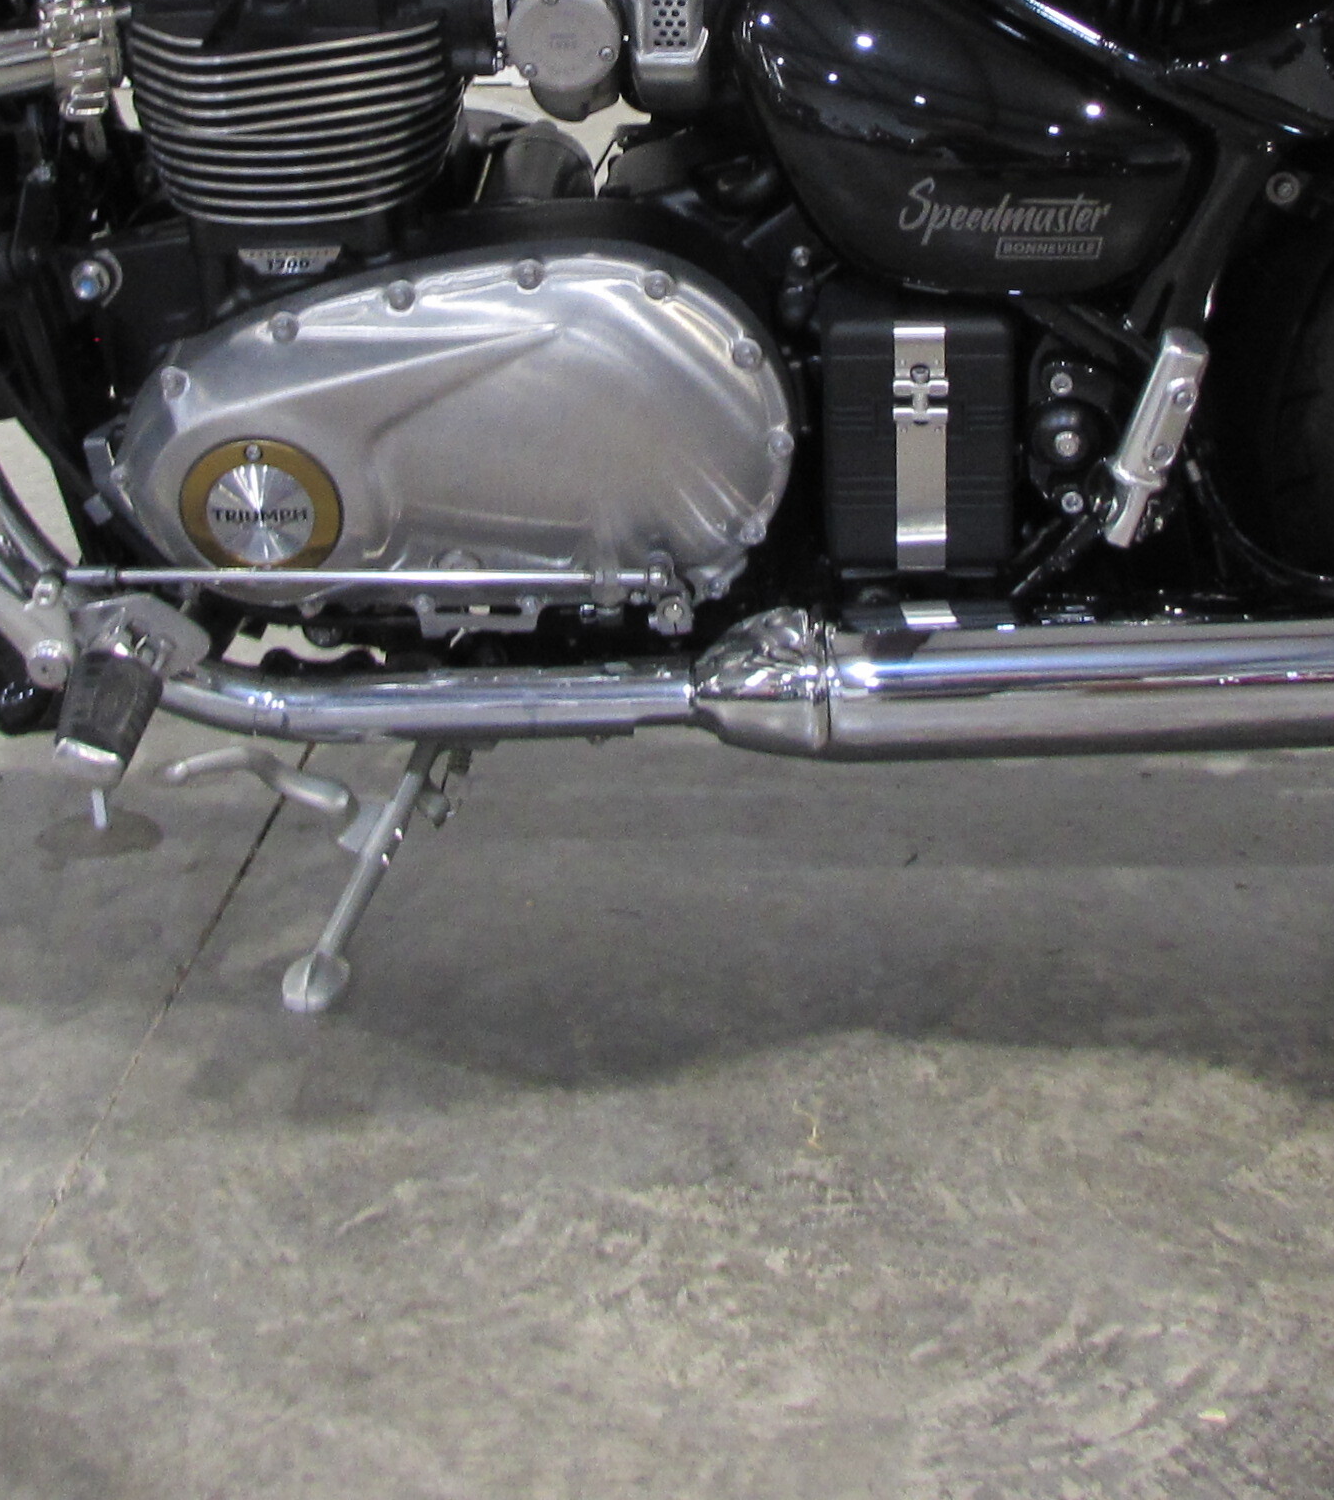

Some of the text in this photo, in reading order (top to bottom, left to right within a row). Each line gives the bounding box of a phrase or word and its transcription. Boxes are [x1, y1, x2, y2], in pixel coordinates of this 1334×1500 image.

[899, 177, 1112, 246] Speedmaster
[1002, 241, 1096, 255] BONNEVILLE
[213, 507, 308, 523] TRIUMPH
